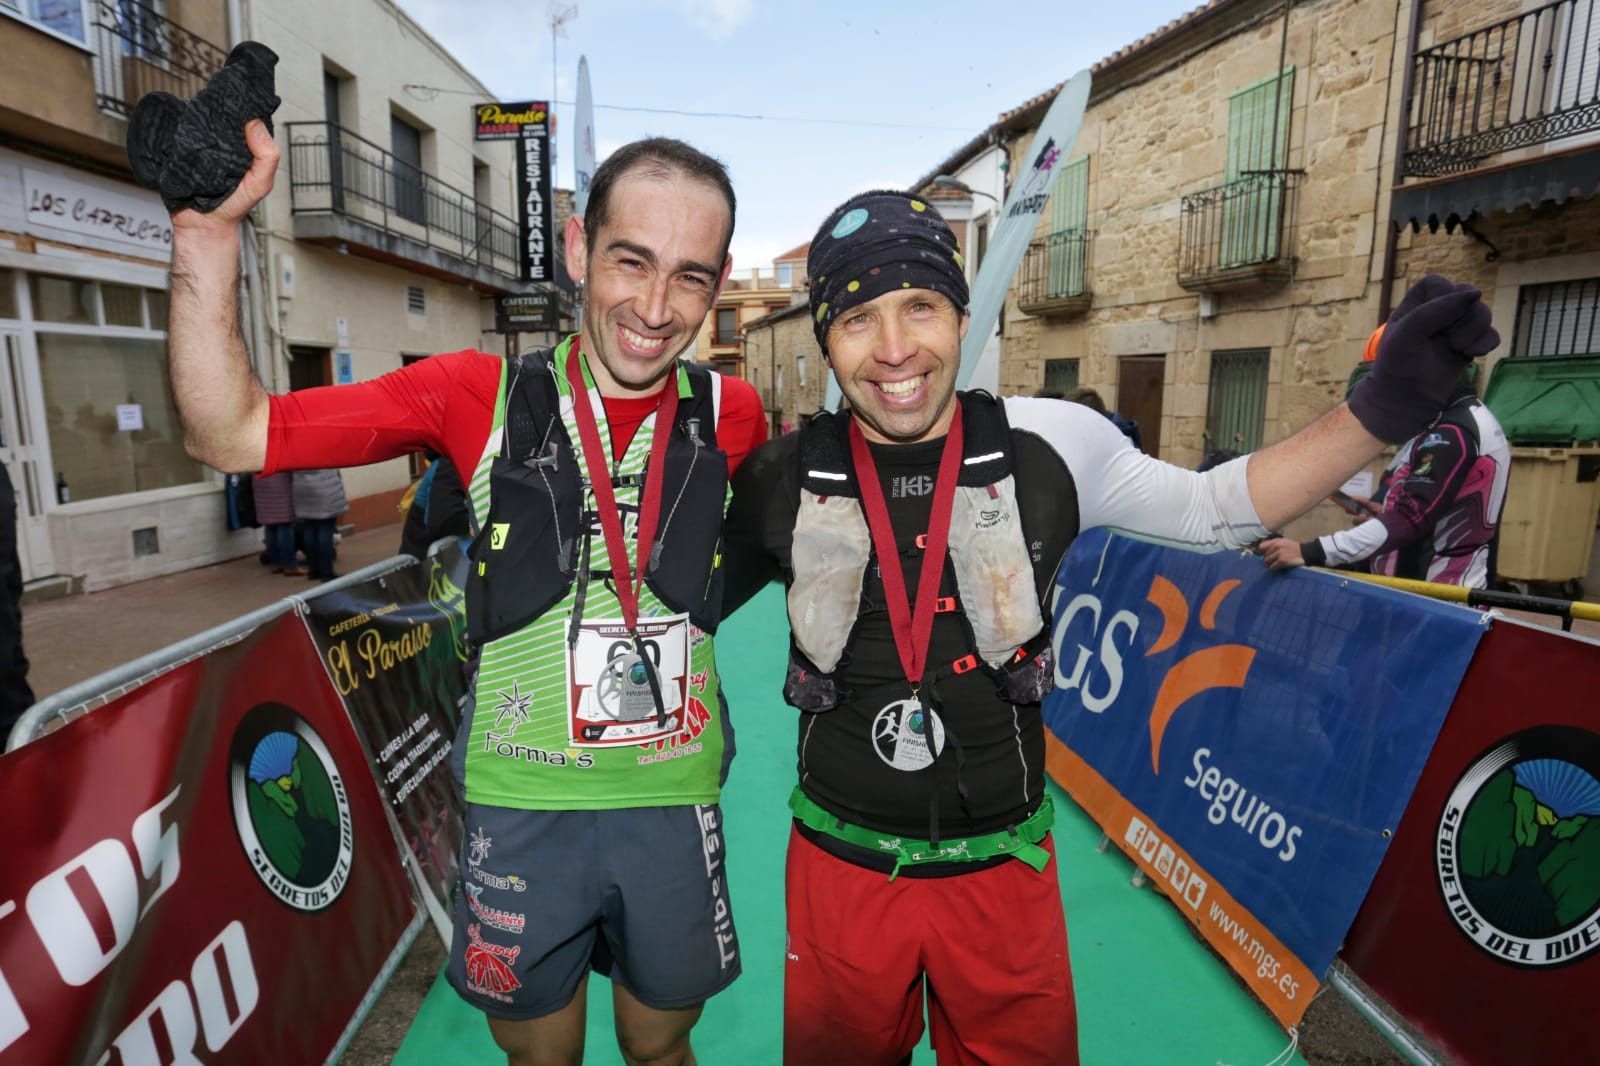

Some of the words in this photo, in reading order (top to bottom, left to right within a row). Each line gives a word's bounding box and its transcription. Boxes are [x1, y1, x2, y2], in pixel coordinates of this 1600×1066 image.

[30, 189, 66, 217] LOS
[525, 138, 544, 279] RESTAURANTE
[328, 640, 359, 696] El
[357, 617, 433, 679] Paraiso
[329, 612, 371, 637] CAFETERÍA
[1051, 584, 1139, 714] GS
[1184, 747, 1304, 862] Seguros
[252, 848, 330, 908] SECRETOS
[330, 857, 350, 895] DEL
[1440, 804, 1485, 936] SECRETOS
[1484, 931, 1535, 962] DEL
[1545, 910, 1600, 962] DUE
[1209, 901, 1299, 1000] www.mgs.es
